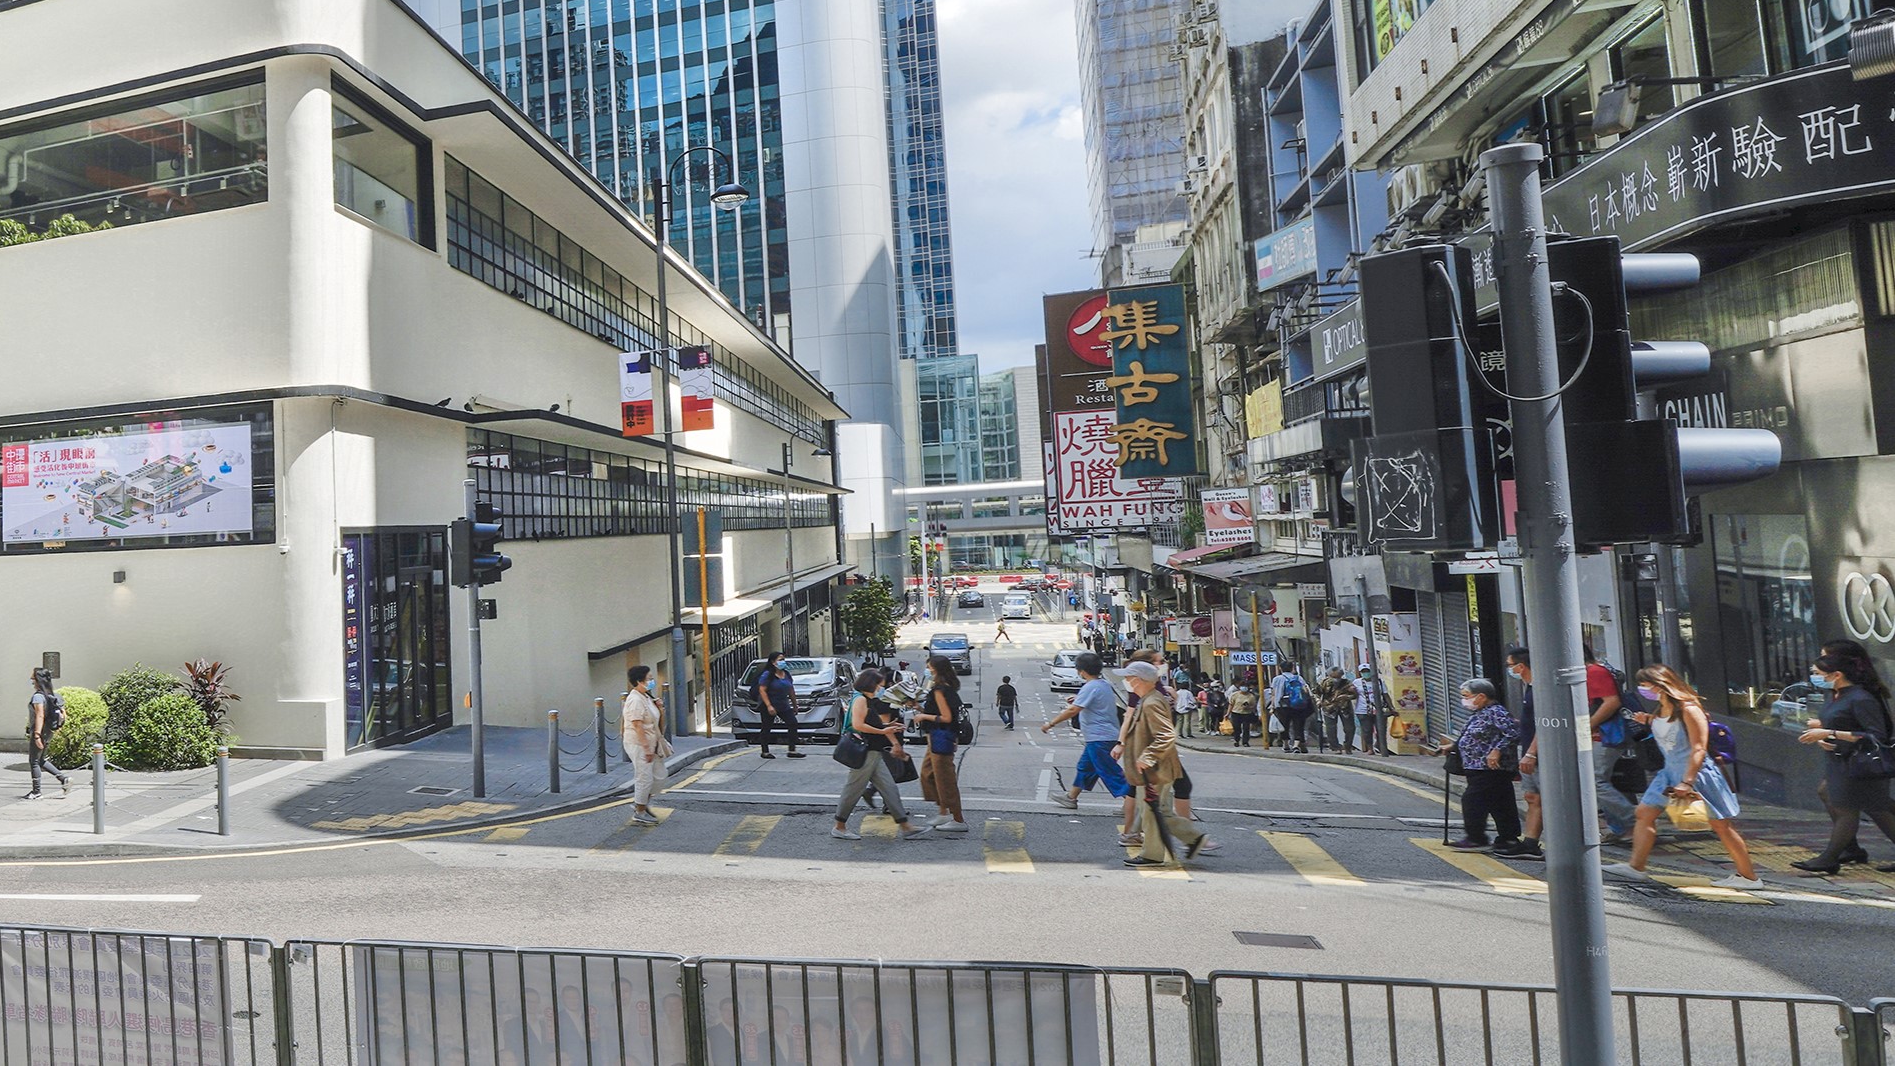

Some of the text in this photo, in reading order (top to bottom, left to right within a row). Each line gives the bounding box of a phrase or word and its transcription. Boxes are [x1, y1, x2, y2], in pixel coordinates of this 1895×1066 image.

[1333, 322, 1360, 356] OPTICAL
[1087, 379, 1109, 392] 酒
[1099, 300, 1188, 468] 集古齋
[1075, 394, 1115, 405] Resta
[1061, 415, 1123, 499] 燒臘
[1062, 504, 1113, 518] WAH
[1063, 518, 1124, 528] SINCE
[1209, 528, 1252, 537] Eyelashes
[1233, 654, 1274, 663] MASSGE
